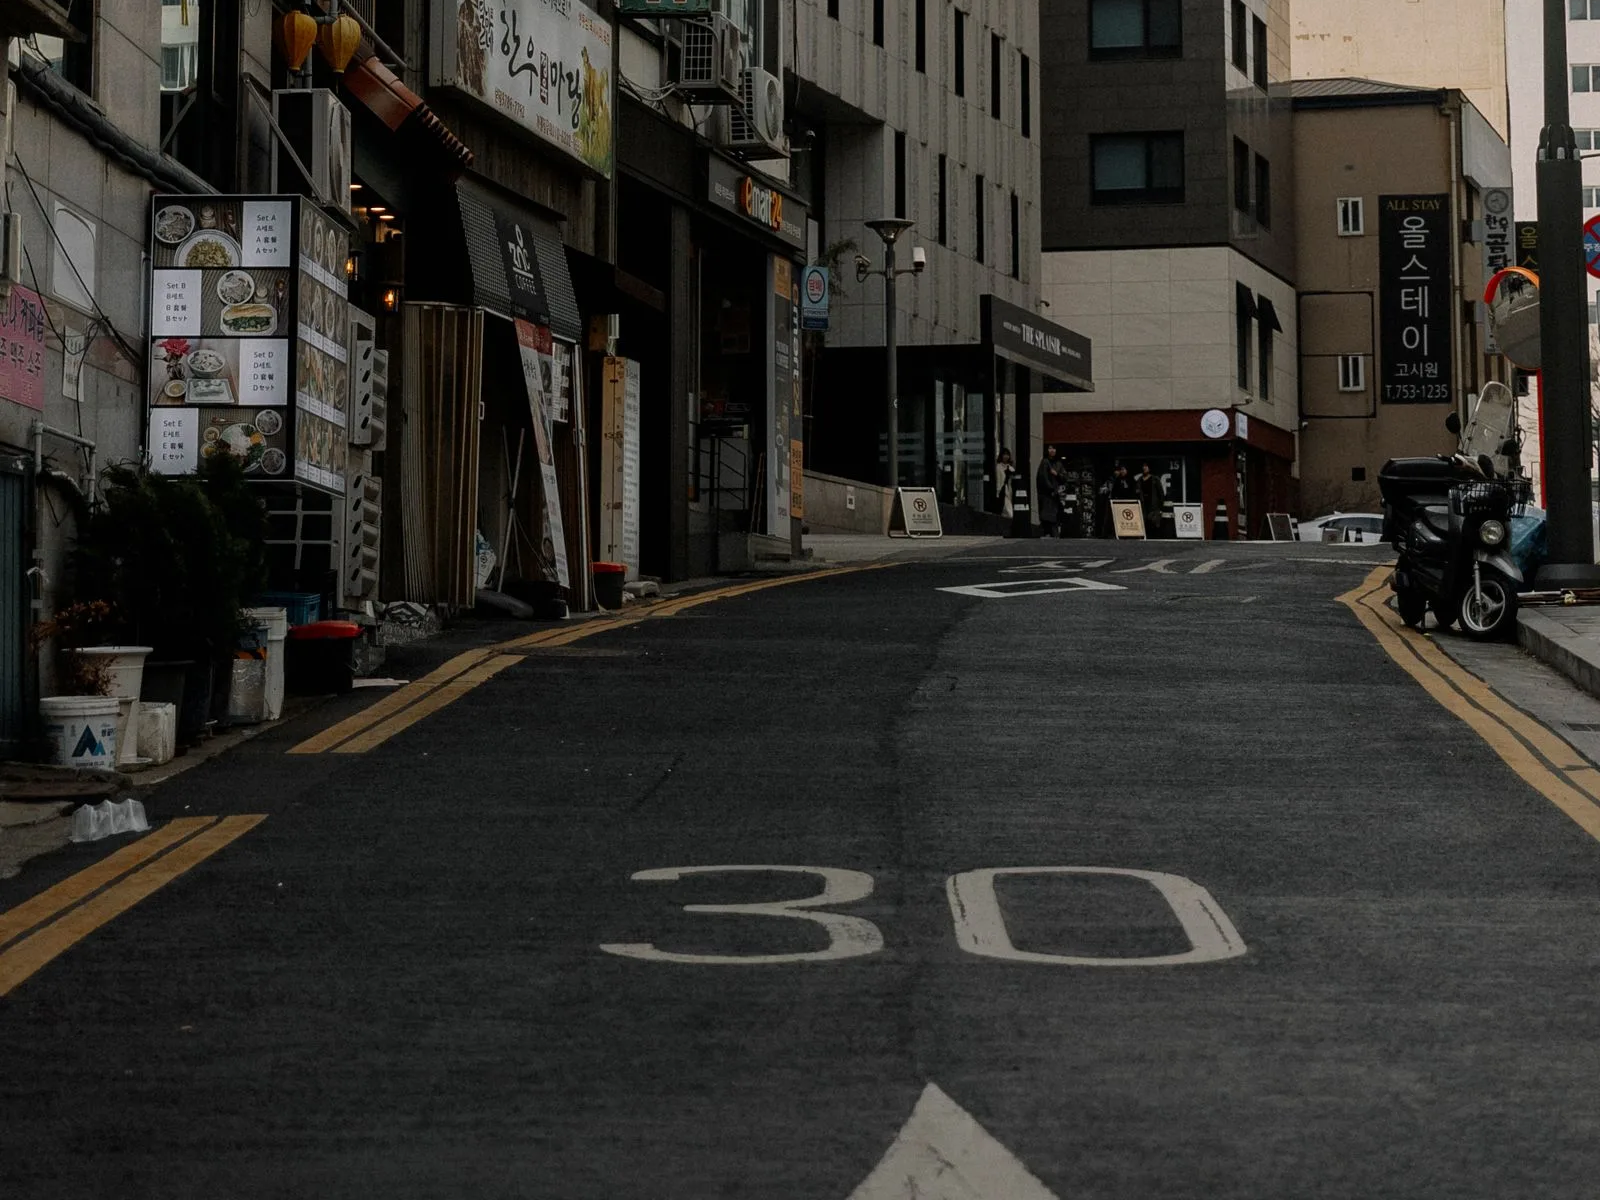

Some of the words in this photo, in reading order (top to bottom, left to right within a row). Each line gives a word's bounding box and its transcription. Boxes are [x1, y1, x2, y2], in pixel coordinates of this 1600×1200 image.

[551, 61, 582, 129] 마당
[743, 176, 784, 231] emart24
[1387, 201, 1409, 211] ALL
[1412, 200, 1442, 210] STAY
[1398, 216, 1431, 356] 올스테이
[1385, 384, 1448, 400] T.753-1235
[1394, 363, 1439, 378] 고시원
[598, 864, 1248, 966] 30
